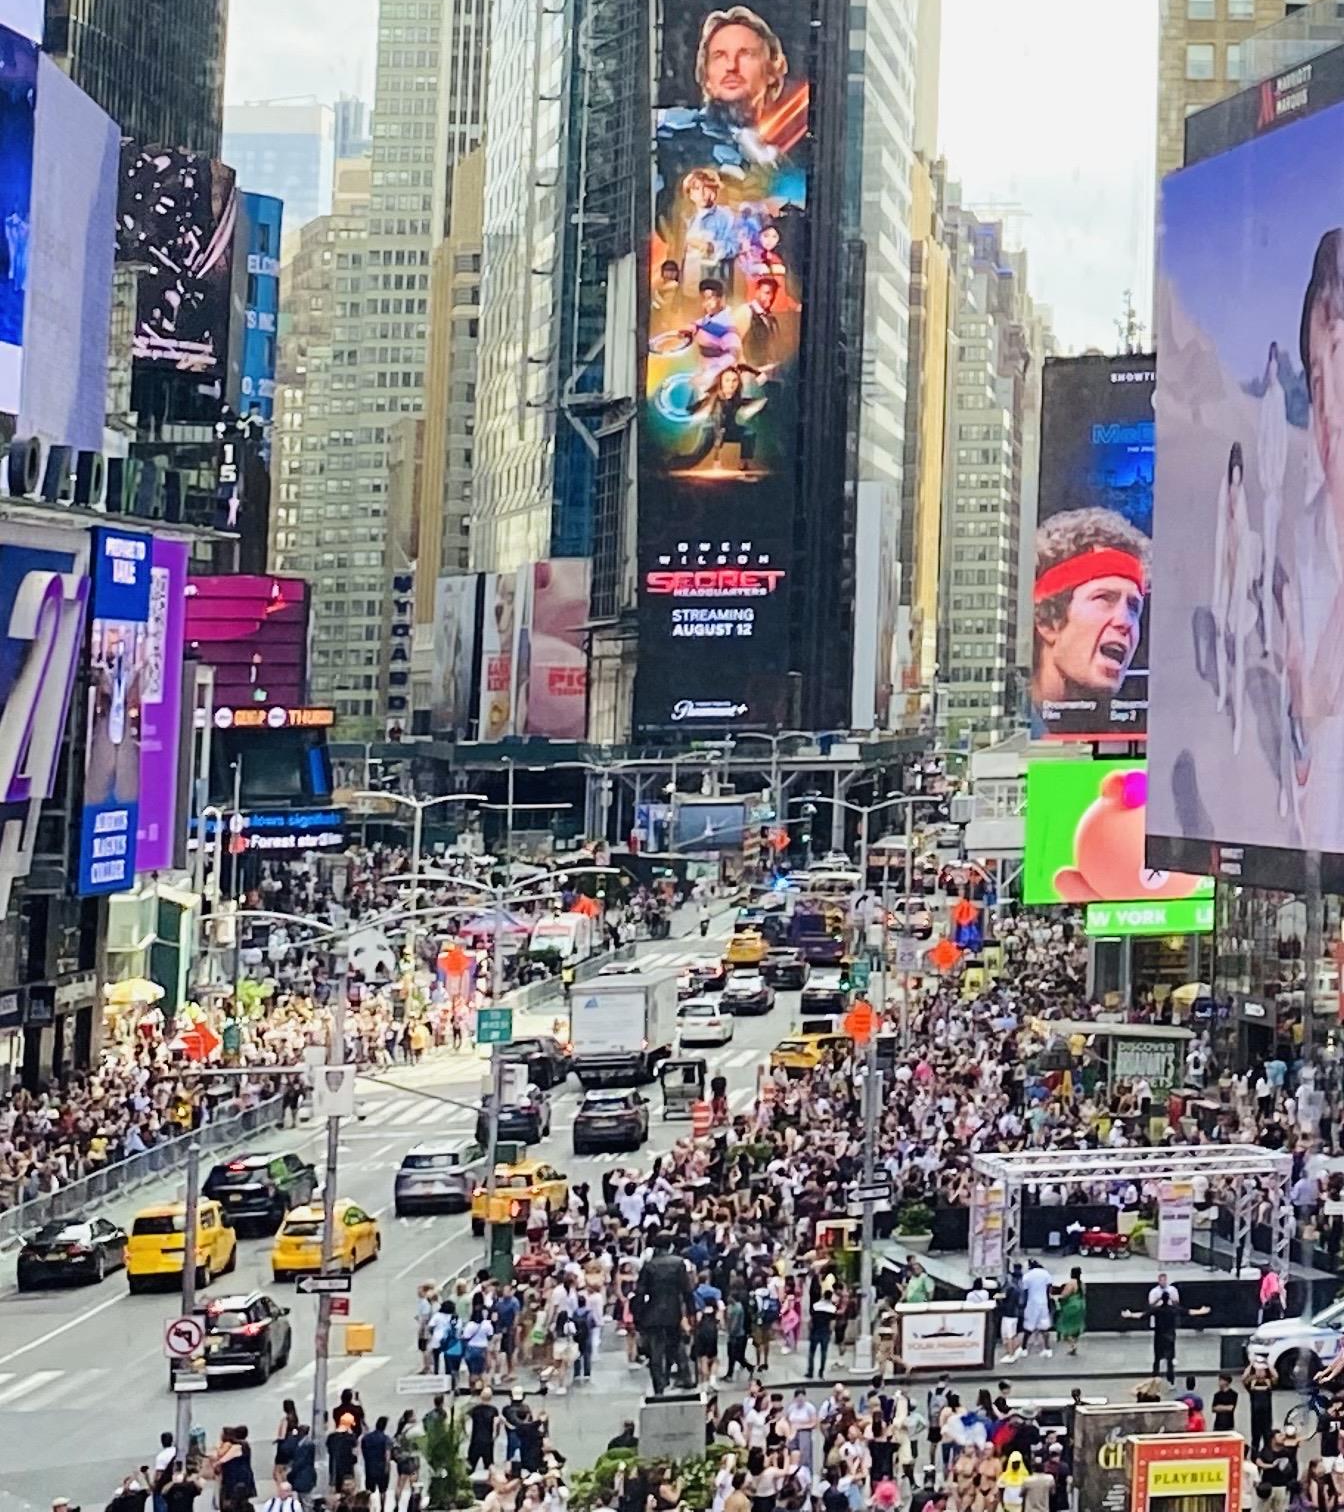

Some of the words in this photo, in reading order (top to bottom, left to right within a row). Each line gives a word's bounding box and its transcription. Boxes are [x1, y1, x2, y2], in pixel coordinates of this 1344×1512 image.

[678, 542, 751, 552] OWEN
[659, 554, 769, 565] WILSON
[647, 570, 785, 593] SECRET
[672, 609, 754, 622] STREAMING
[672, 623, 732, 636] AUGUST
[736, 623, 752, 636] 12
[1115, 909, 1167, 926] YORK
[1154, 1472, 1224, 1485] PLAYBILL
